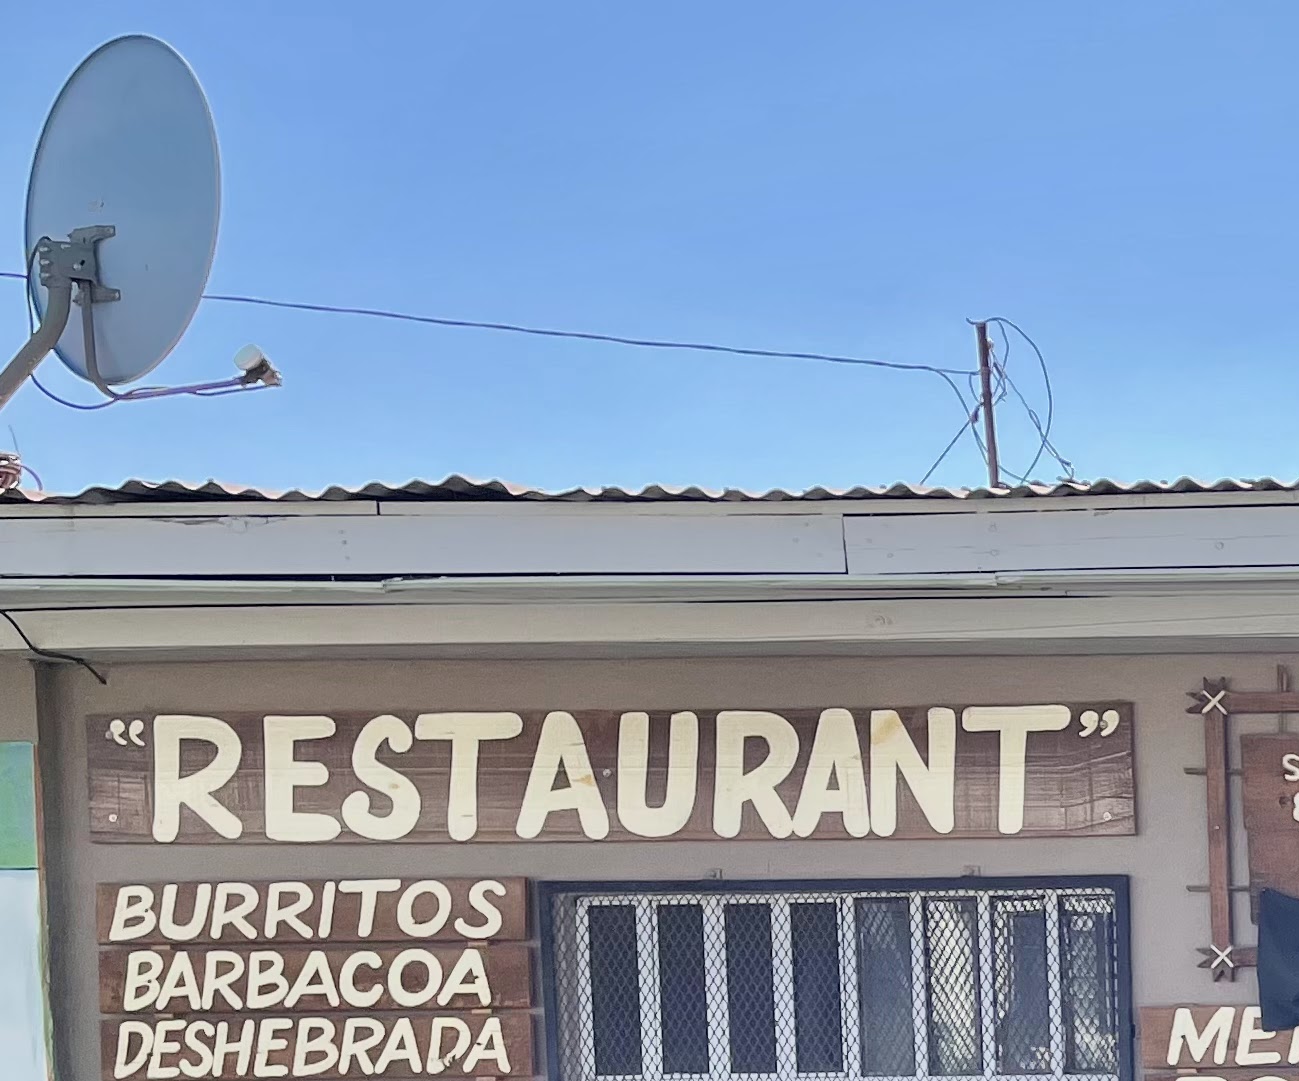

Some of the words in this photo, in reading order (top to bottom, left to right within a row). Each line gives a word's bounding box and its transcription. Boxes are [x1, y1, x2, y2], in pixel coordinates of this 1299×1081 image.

[109, 705, 1119, 843] “RESTAURANT”
[109, 879, 507, 941] BURRITOS
[124, 948, 492, 1012] BARBACOA
[114, 1016, 512, 1080] DESHEBRADA
